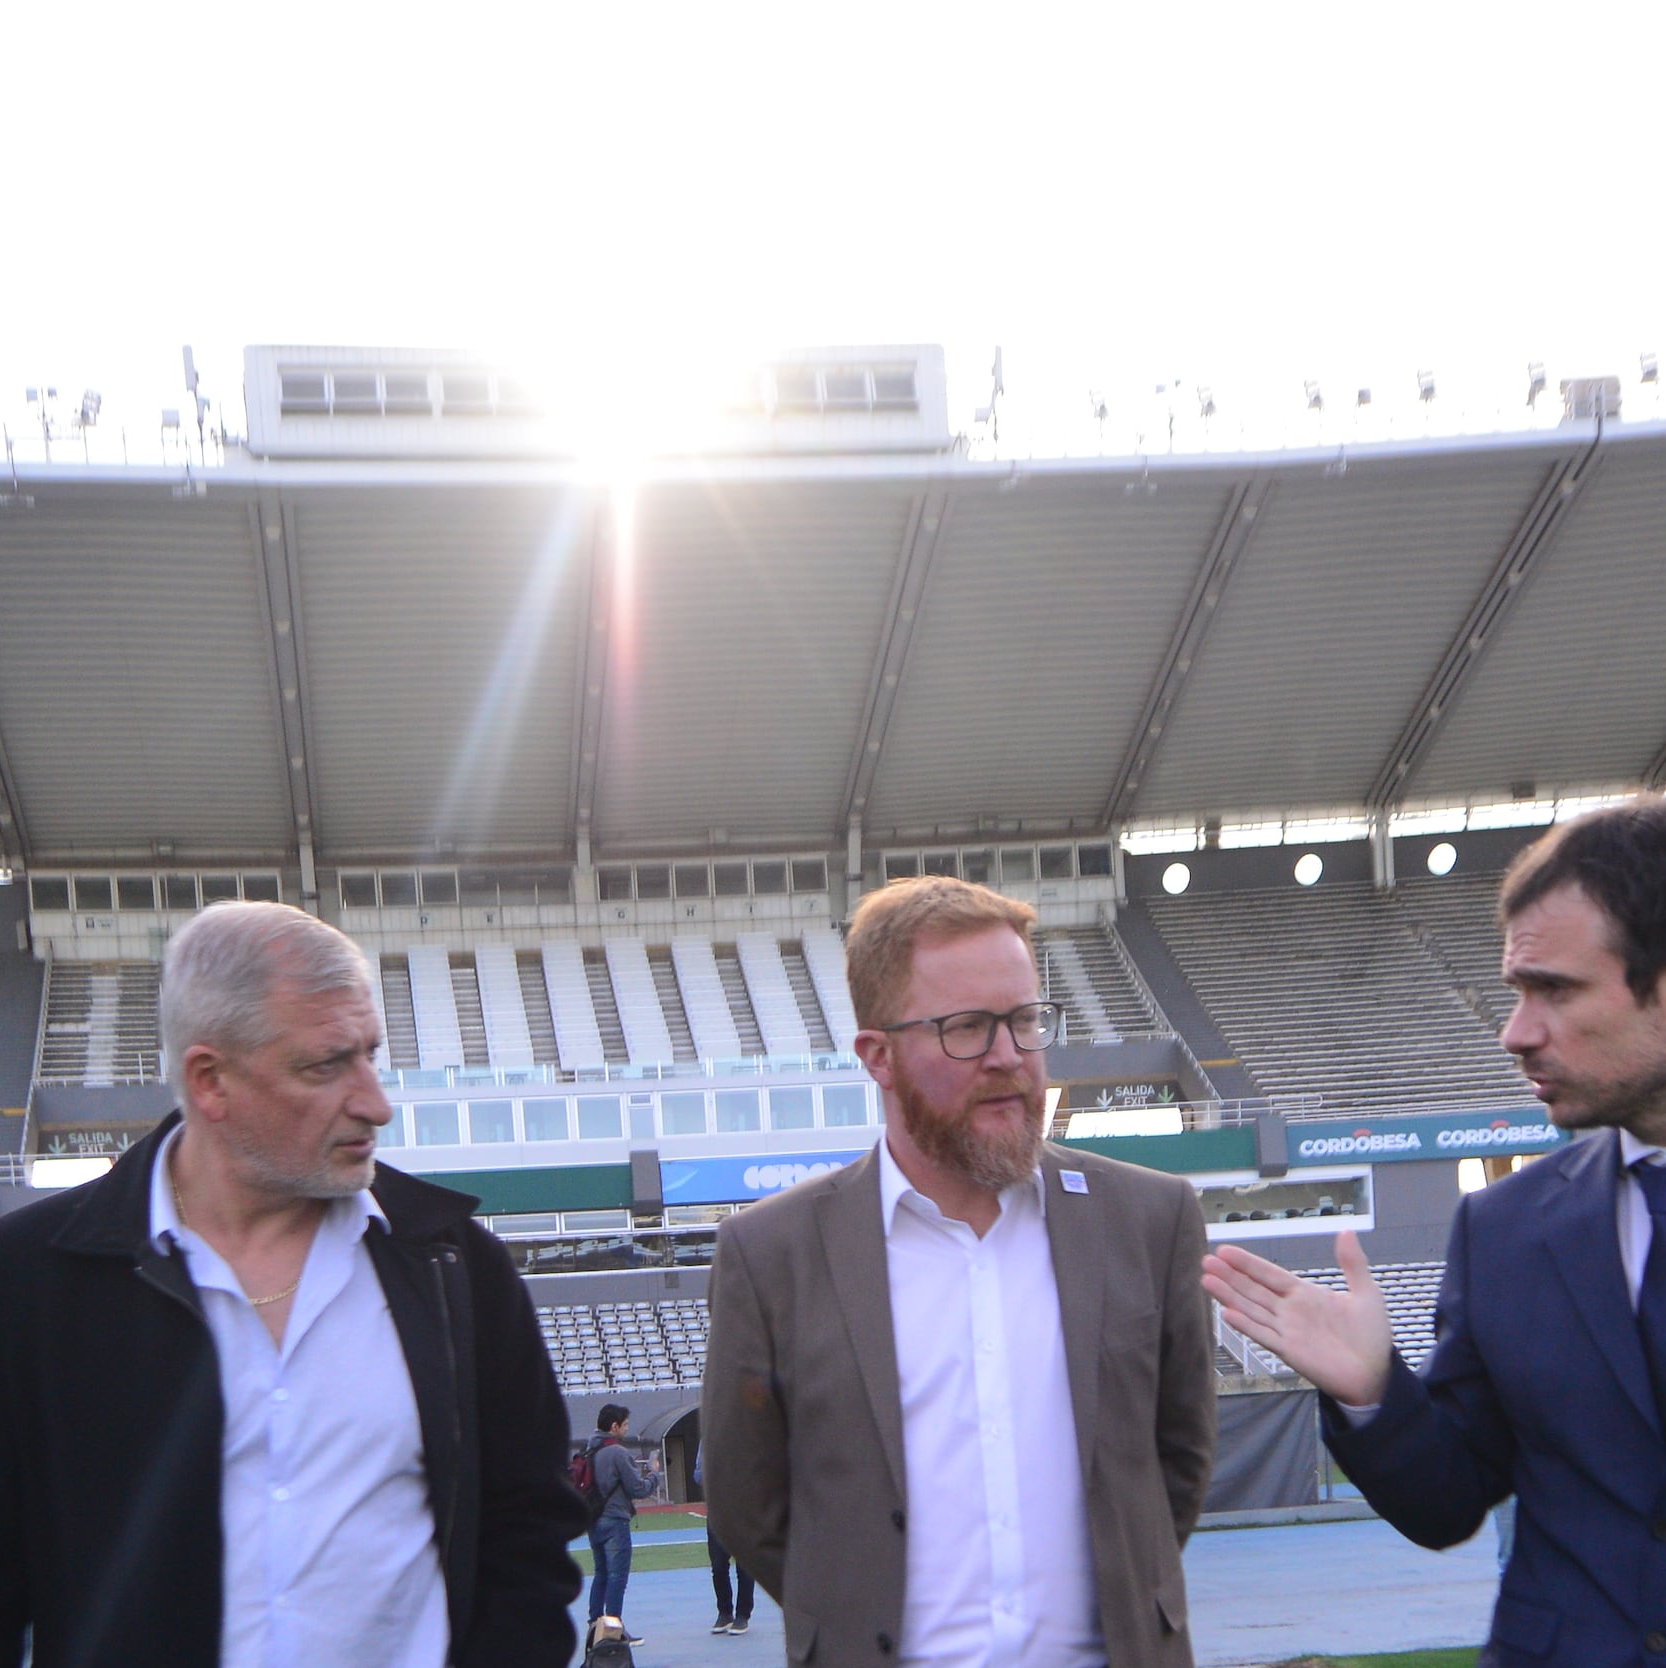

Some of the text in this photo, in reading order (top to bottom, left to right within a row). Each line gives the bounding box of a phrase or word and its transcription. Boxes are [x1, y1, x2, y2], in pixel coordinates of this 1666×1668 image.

[1115, 1085, 1156, 1096] SALIDA
[1124, 1096, 1148, 1106] EXIT
[68, 1131, 114, 1145] SALIDA
[1299, 1123, 1560, 1157] CORDOBESA CORDOBESA
